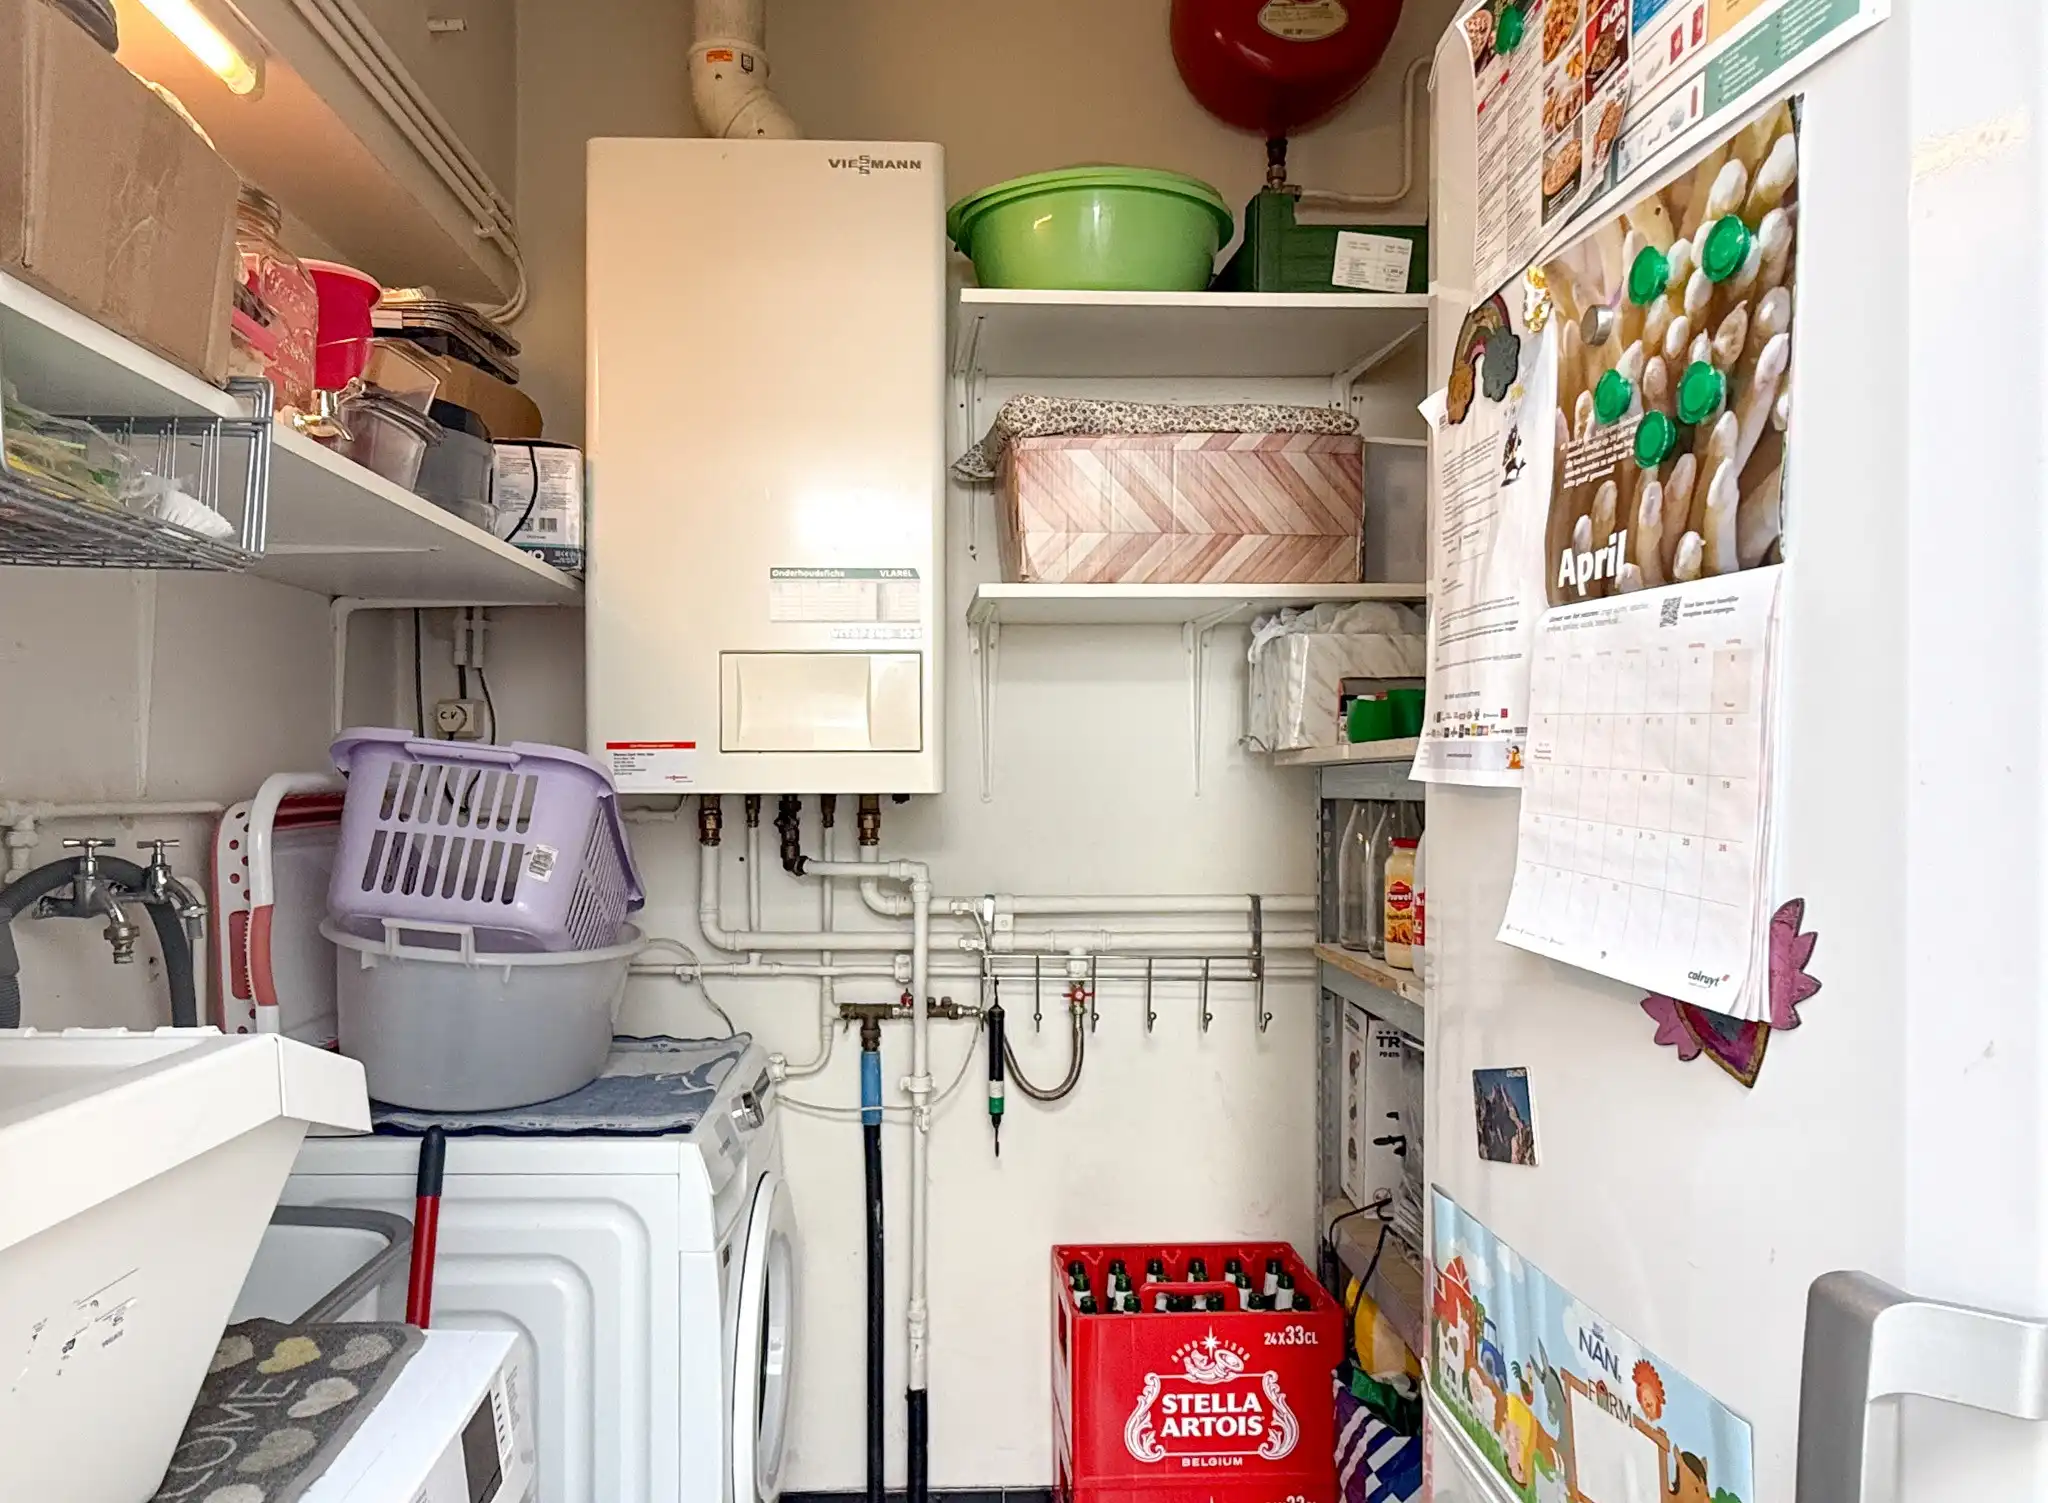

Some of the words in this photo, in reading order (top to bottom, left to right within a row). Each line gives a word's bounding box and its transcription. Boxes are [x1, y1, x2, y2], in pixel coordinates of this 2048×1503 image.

[1558, 529, 1627, 596] April
[1687, 970, 1720, 989] colruyt
[1579, 1326, 1620, 1381] NAN
[1161, 1392, 1262, 1414] STELLA
[1160, 1415, 1264, 1438] ARTOIS
[1181, 1456, 1243, 1468] BELGIUM
